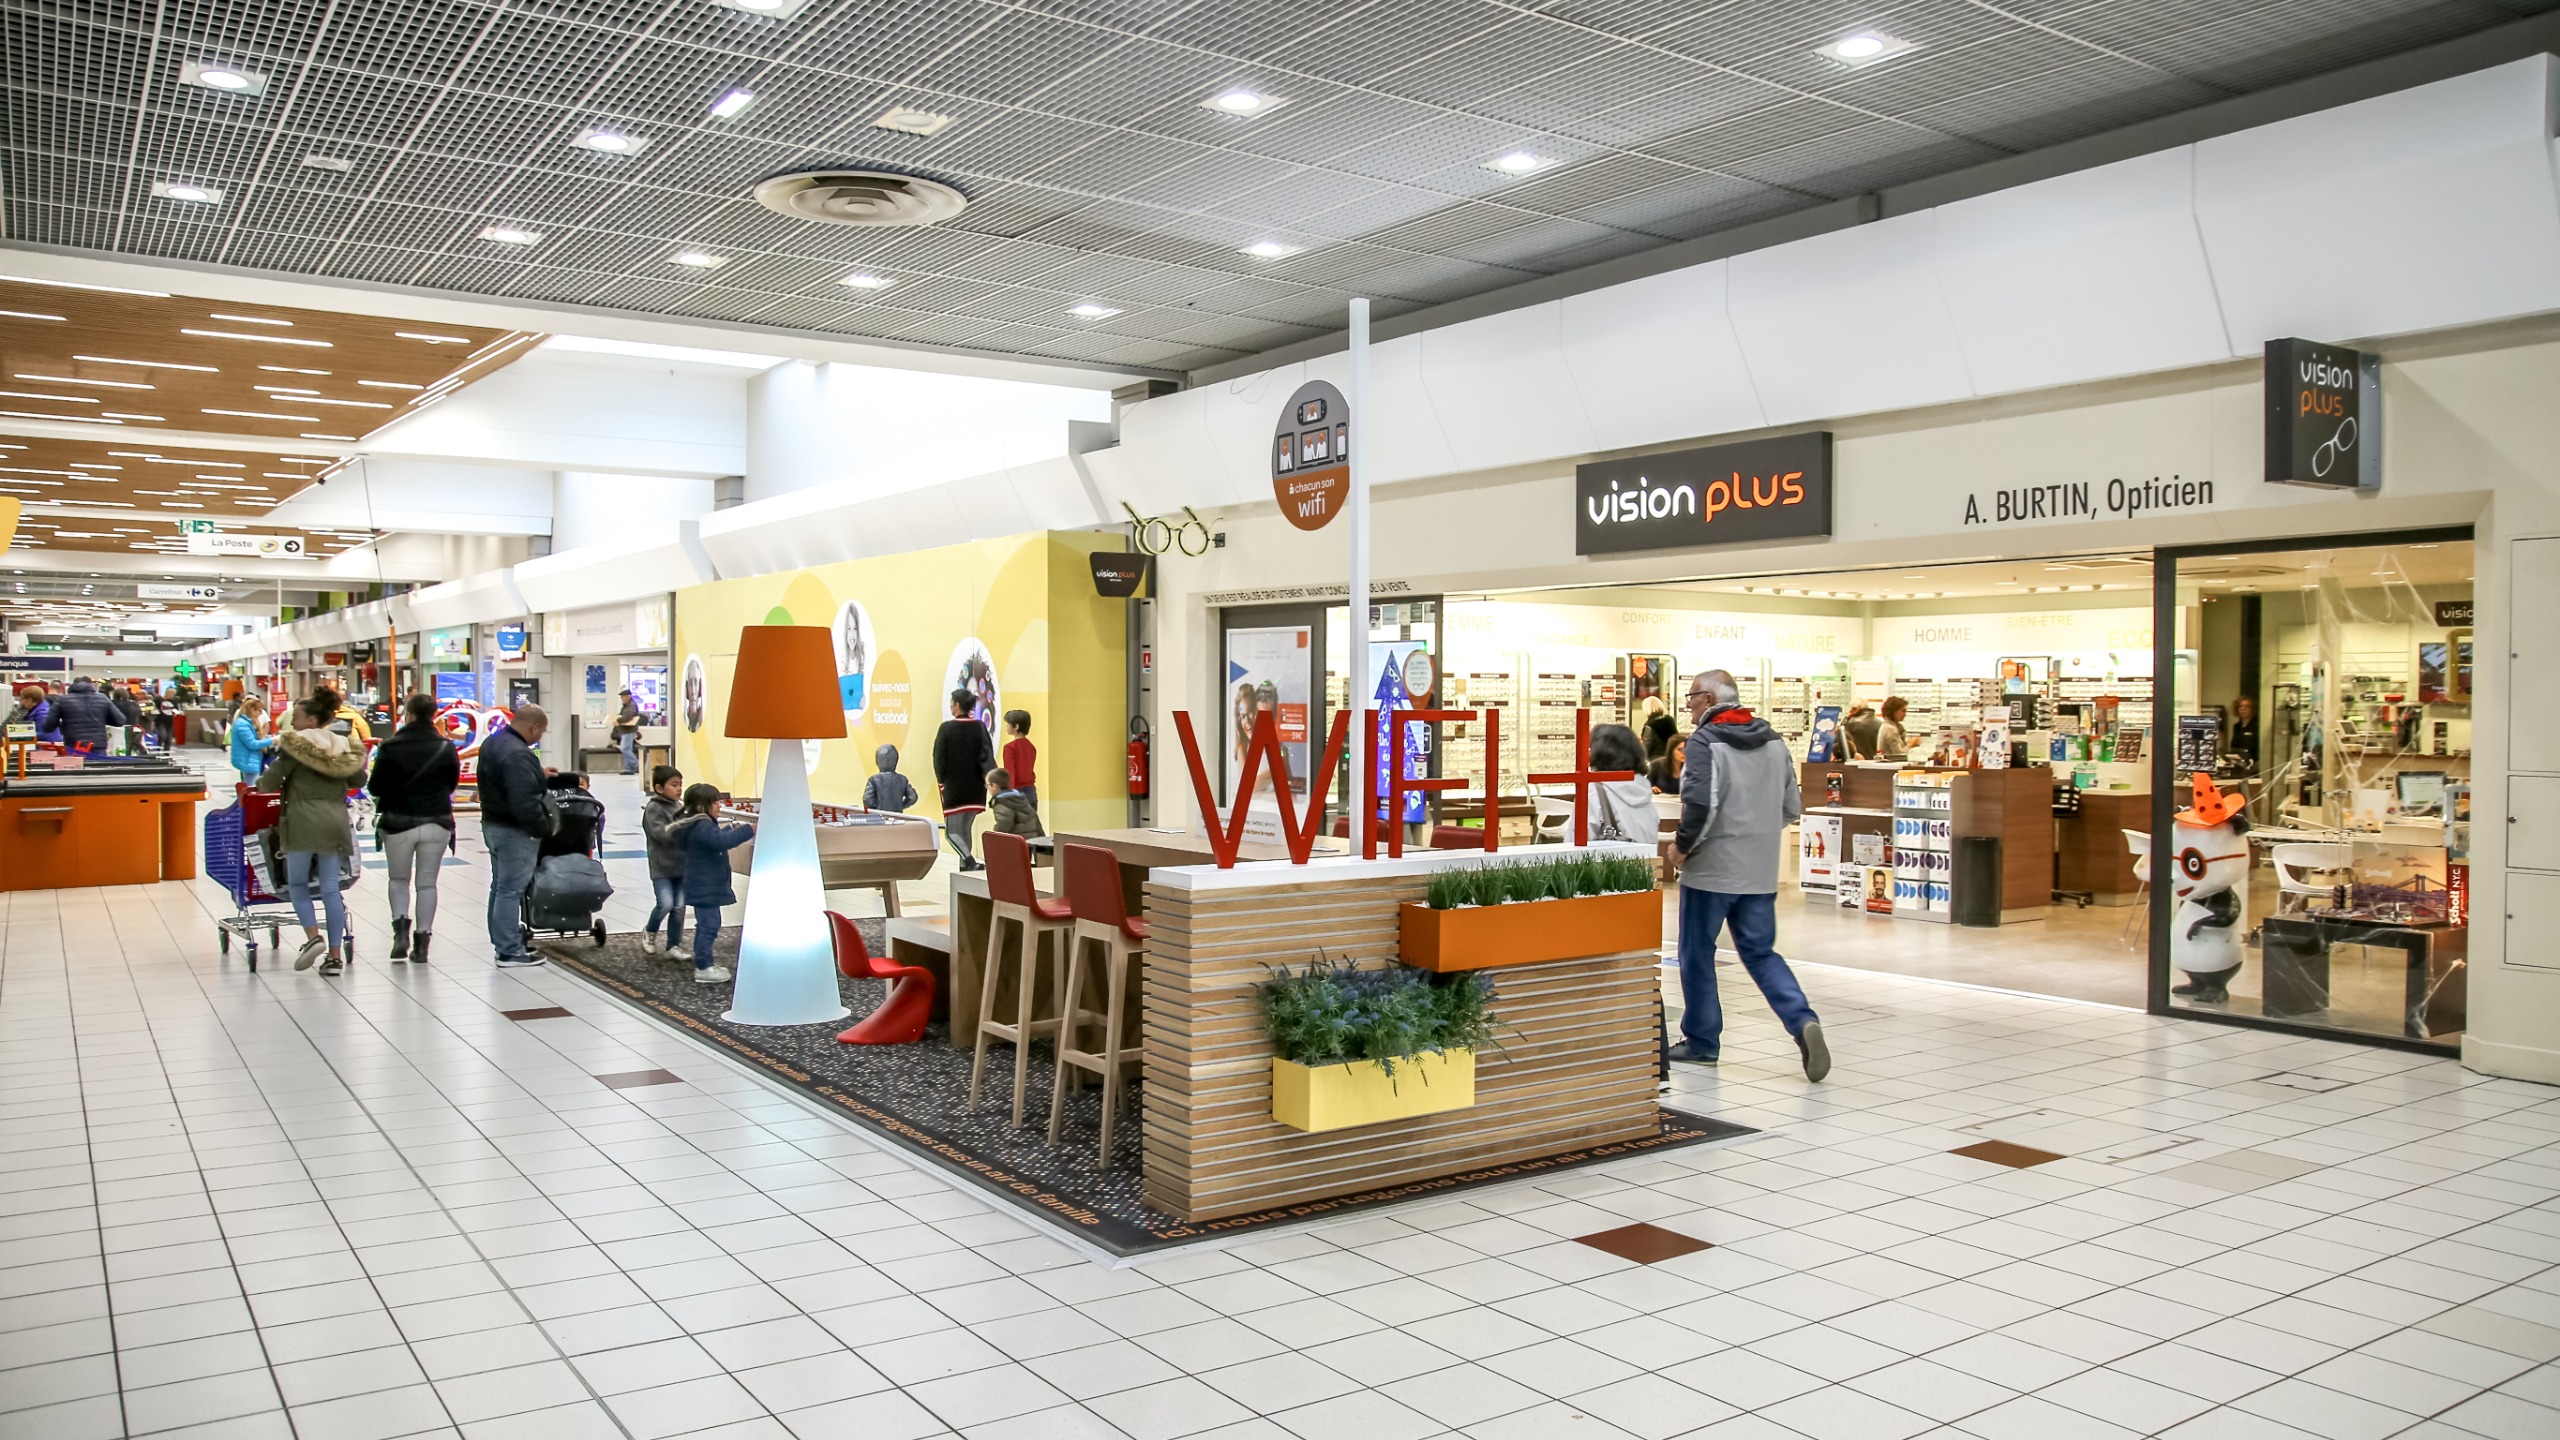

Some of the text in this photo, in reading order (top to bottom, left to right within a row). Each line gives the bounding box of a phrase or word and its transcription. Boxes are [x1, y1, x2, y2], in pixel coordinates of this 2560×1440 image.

[2300, 353, 2353, 391] vision
[2300, 389, 2343, 418] plus
[1295, 481, 1320, 493] chacun
[1321, 478, 1335, 489] son
[1298, 491, 1325, 518] wifi
[1588, 470, 1805, 526] vision plus
[1964, 475, 2213, 525] A. BURTIN, Opticien
[211, 539, 253, 548] La Poste
[1096, 569, 1136, 579] vision plus
[149, 587, 183, 596] Carrefour
[1387, 581, 1411, 591] VENTE
[1444, 614, 1495, 631] EMME
[1622, 612, 1672, 624] CONFORT
[1695, 624, 1746, 640] ENFANT
[1915, 627, 1973, 642] HOMME
[1775, 634, 1835, 652] NATURE
[872, 680, 910, 693] suivez-nous
[873, 708, 909, 725] facebook
[2449, 890, 2461, 925] Schott
[832, 1091, 862, 1109] nous
[859, 1105, 933, 1146] partageons
[934, 1143, 972, 1164] tous
[965, 1159, 992, 1172] un
[987, 1169, 1016, 1182] air
[1010, 1179, 1038, 1196] de
[1037, 1192, 1100, 1226] famille
[1153, 1128, 1707, 1240] ici, nous partageons tous un air de famille
